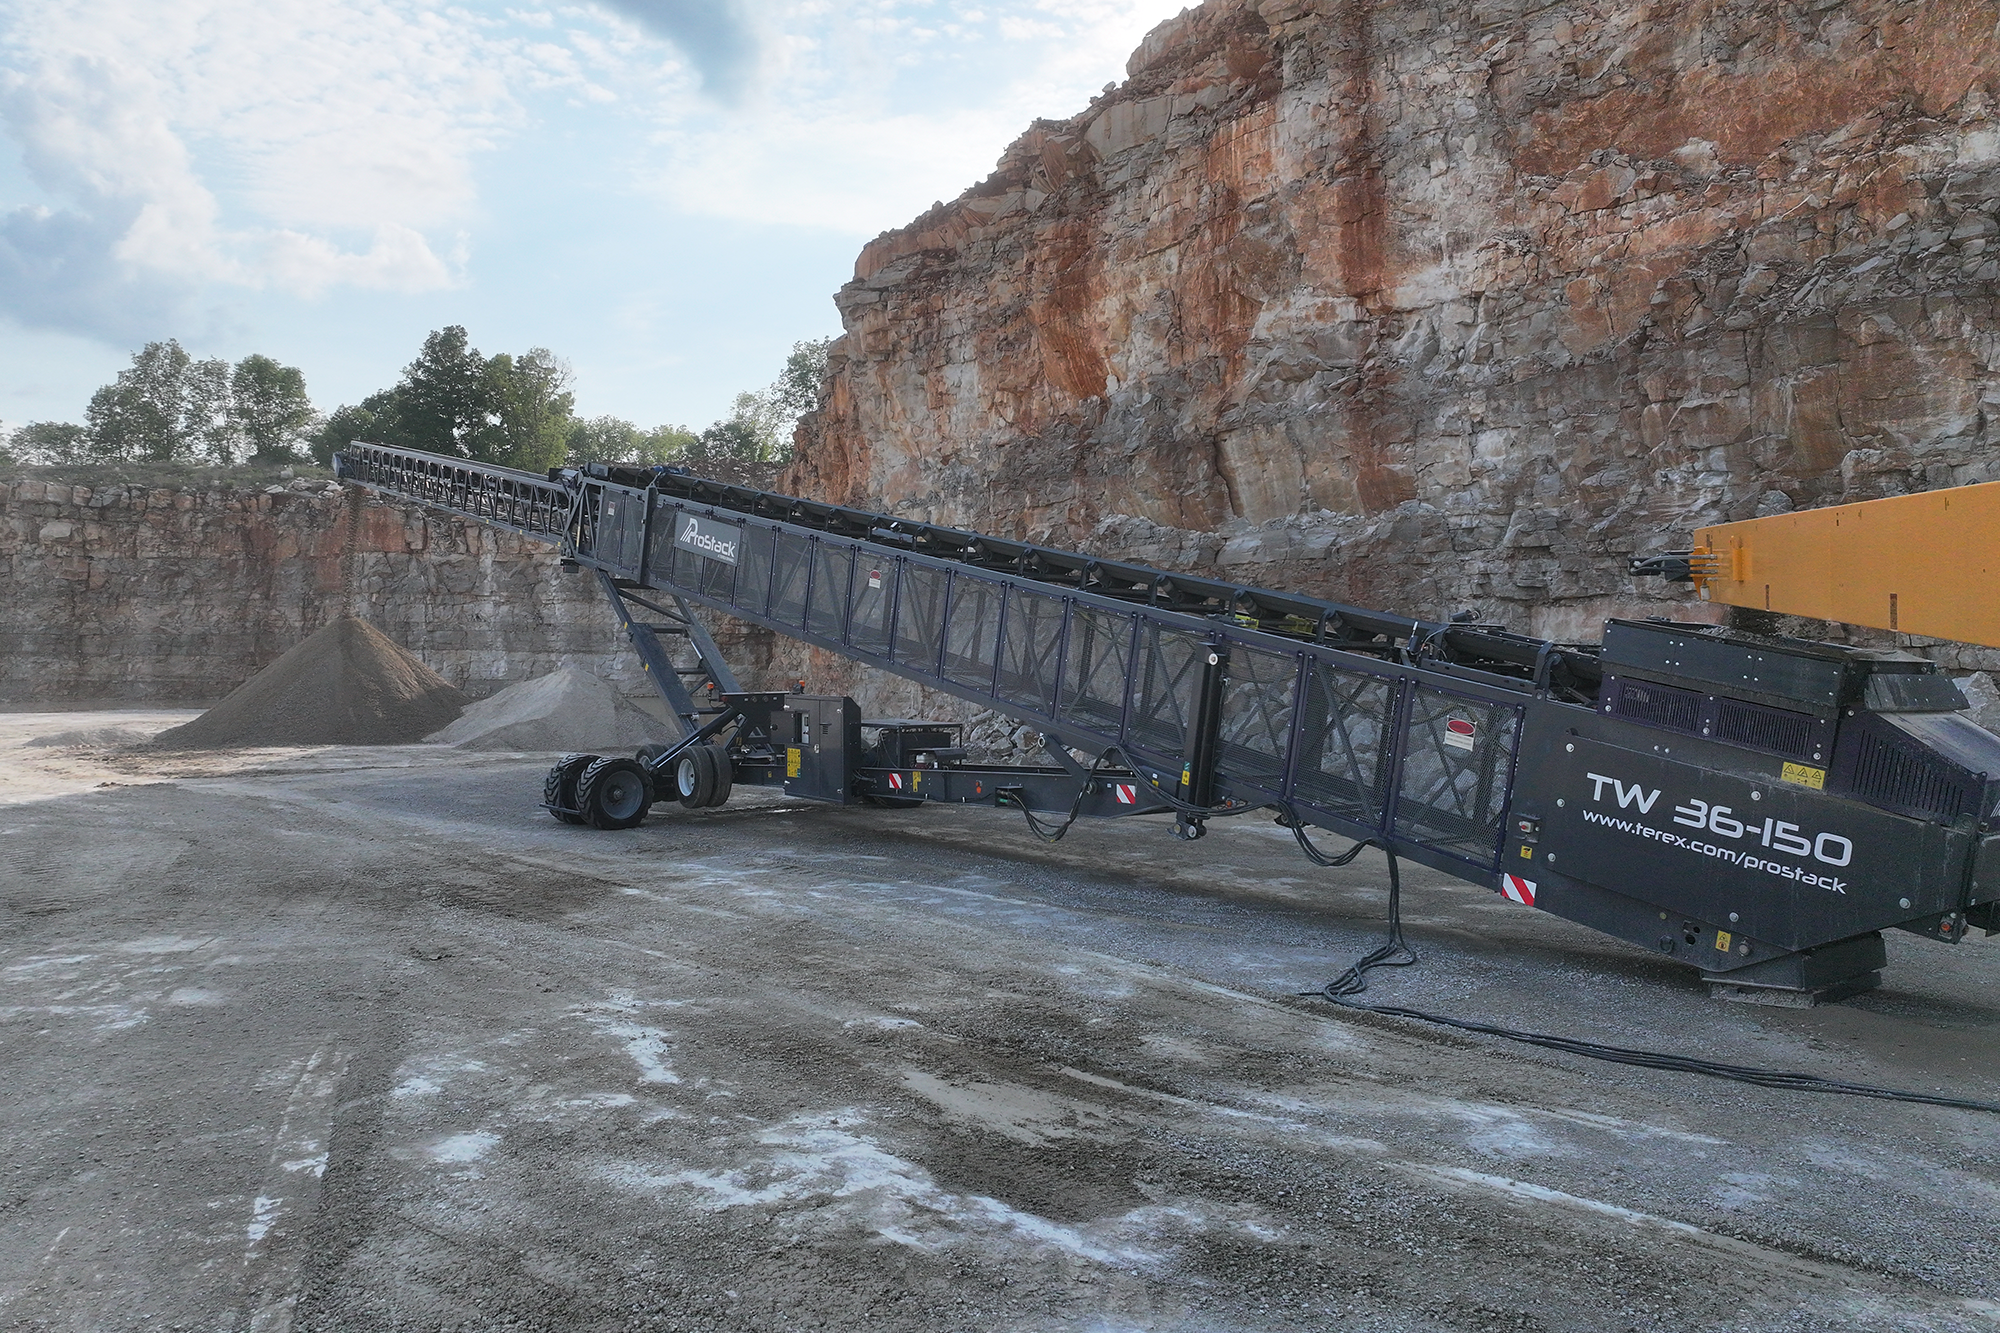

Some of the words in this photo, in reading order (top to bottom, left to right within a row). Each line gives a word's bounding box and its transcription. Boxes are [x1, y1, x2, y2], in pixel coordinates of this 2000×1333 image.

[680, 517, 736, 557] ProStack
[1583, 809, 1847, 895] www.terex.com/prostack
[1587, 772, 1661, 814] TW
[1673, 798, 1853, 867] 36-150
